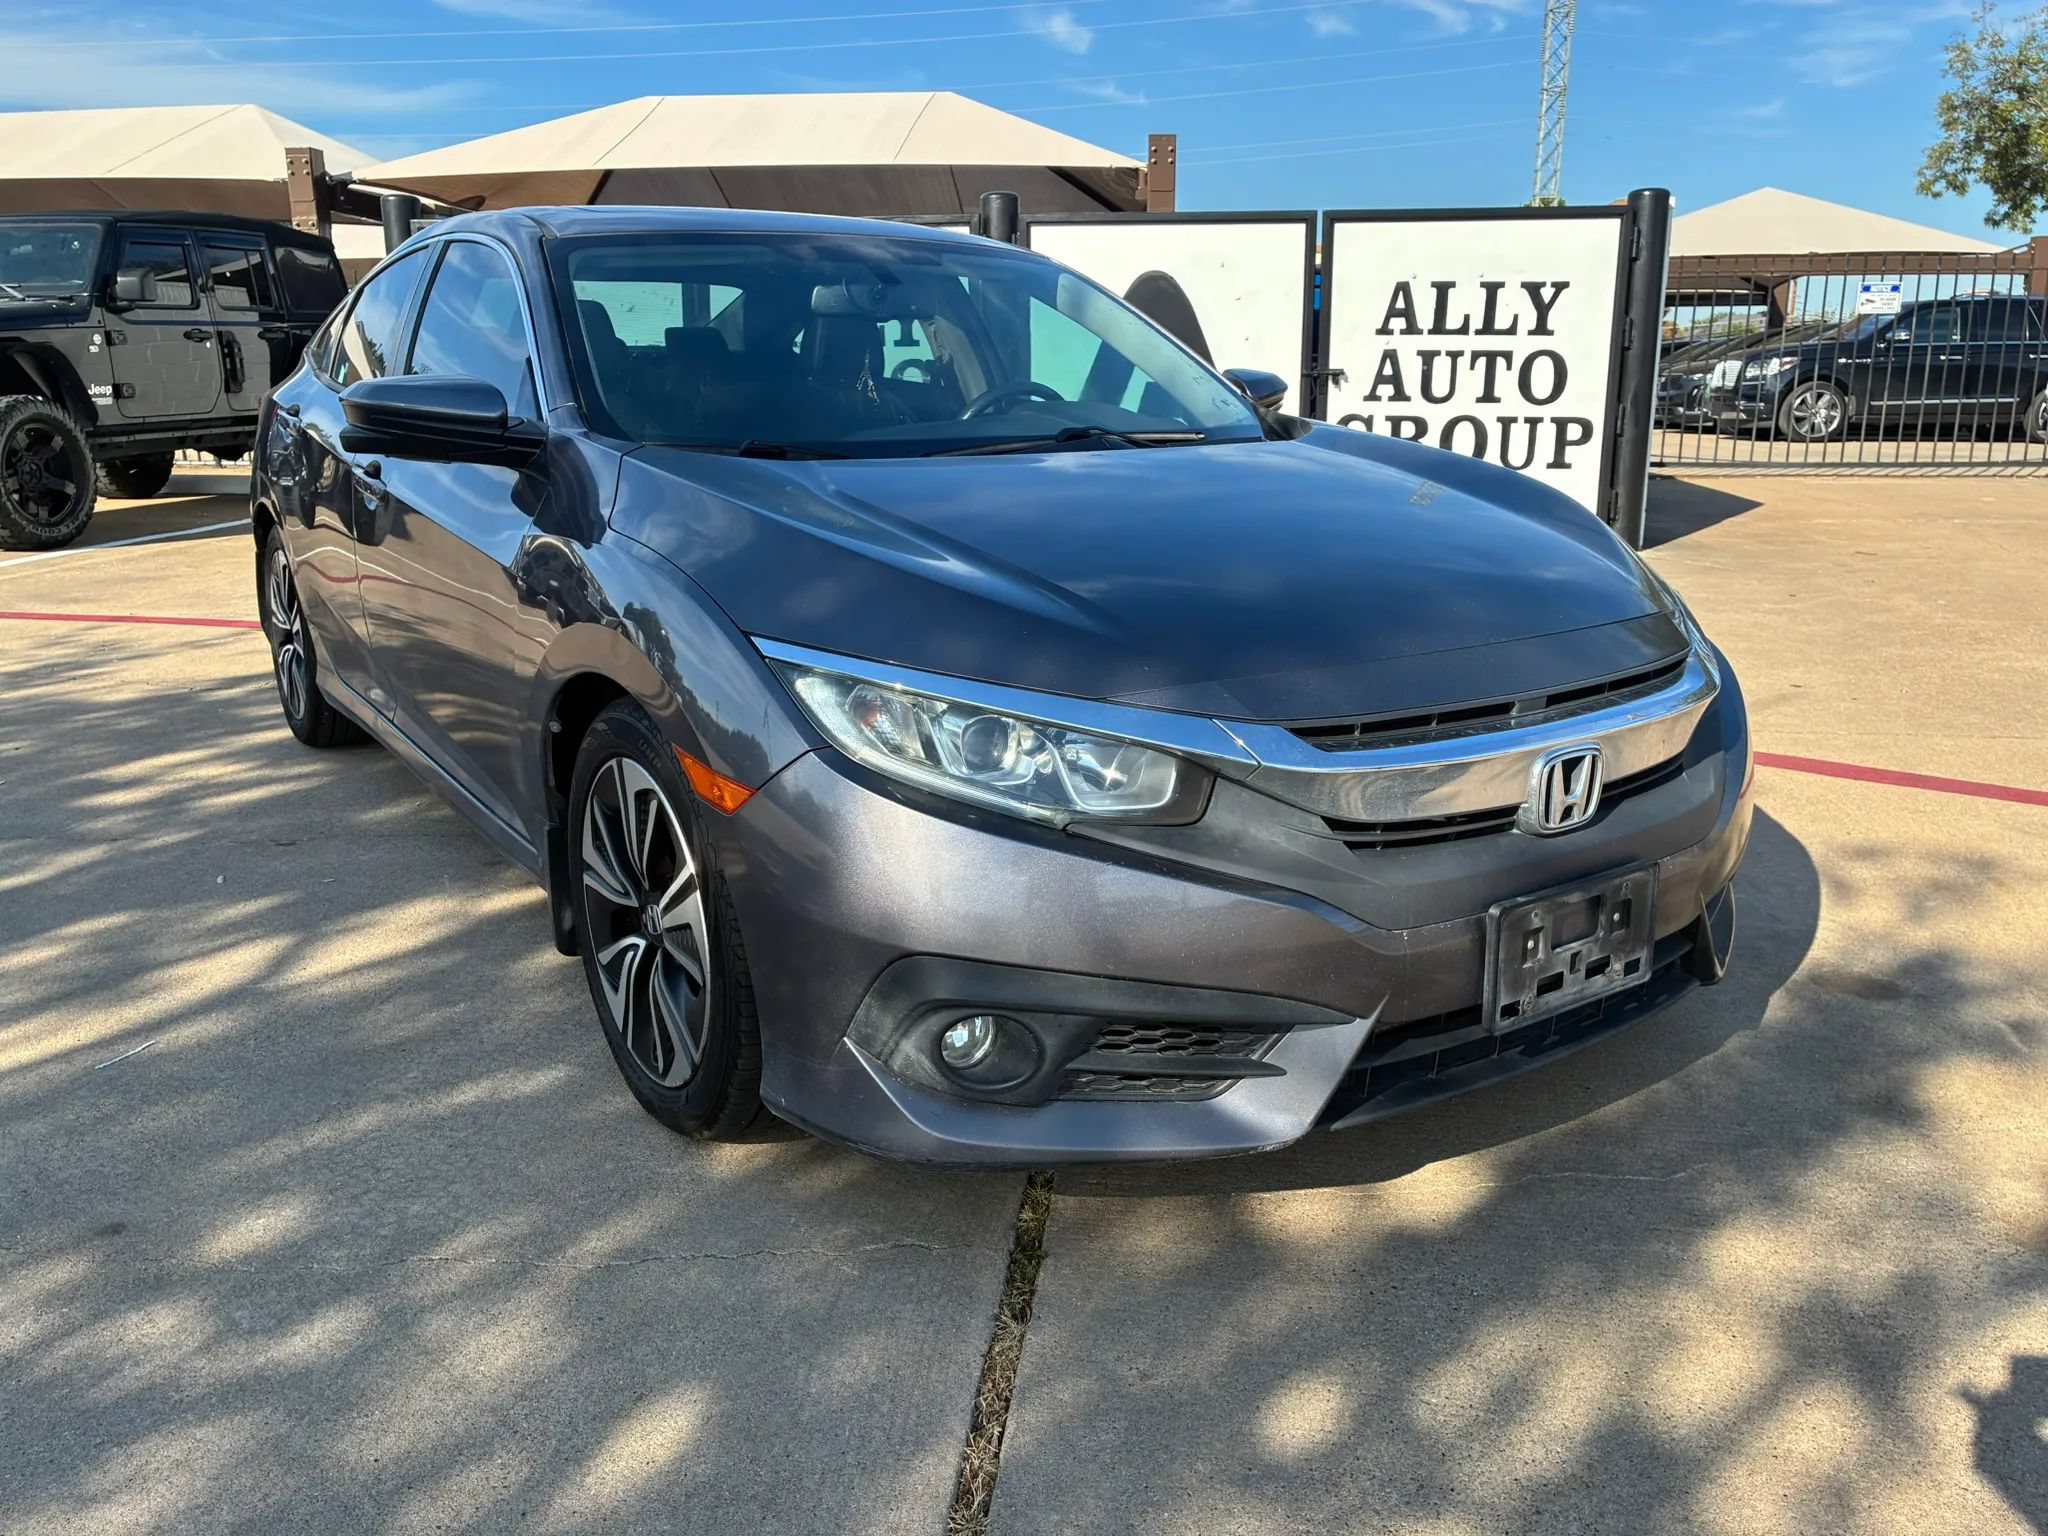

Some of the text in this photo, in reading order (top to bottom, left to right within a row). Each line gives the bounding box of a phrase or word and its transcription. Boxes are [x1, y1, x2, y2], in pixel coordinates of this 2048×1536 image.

[1375, 281, 1570, 336] ALLY
[88, 384, 113, 396] Jeep
[1363, 349, 1568, 405] AUTO
